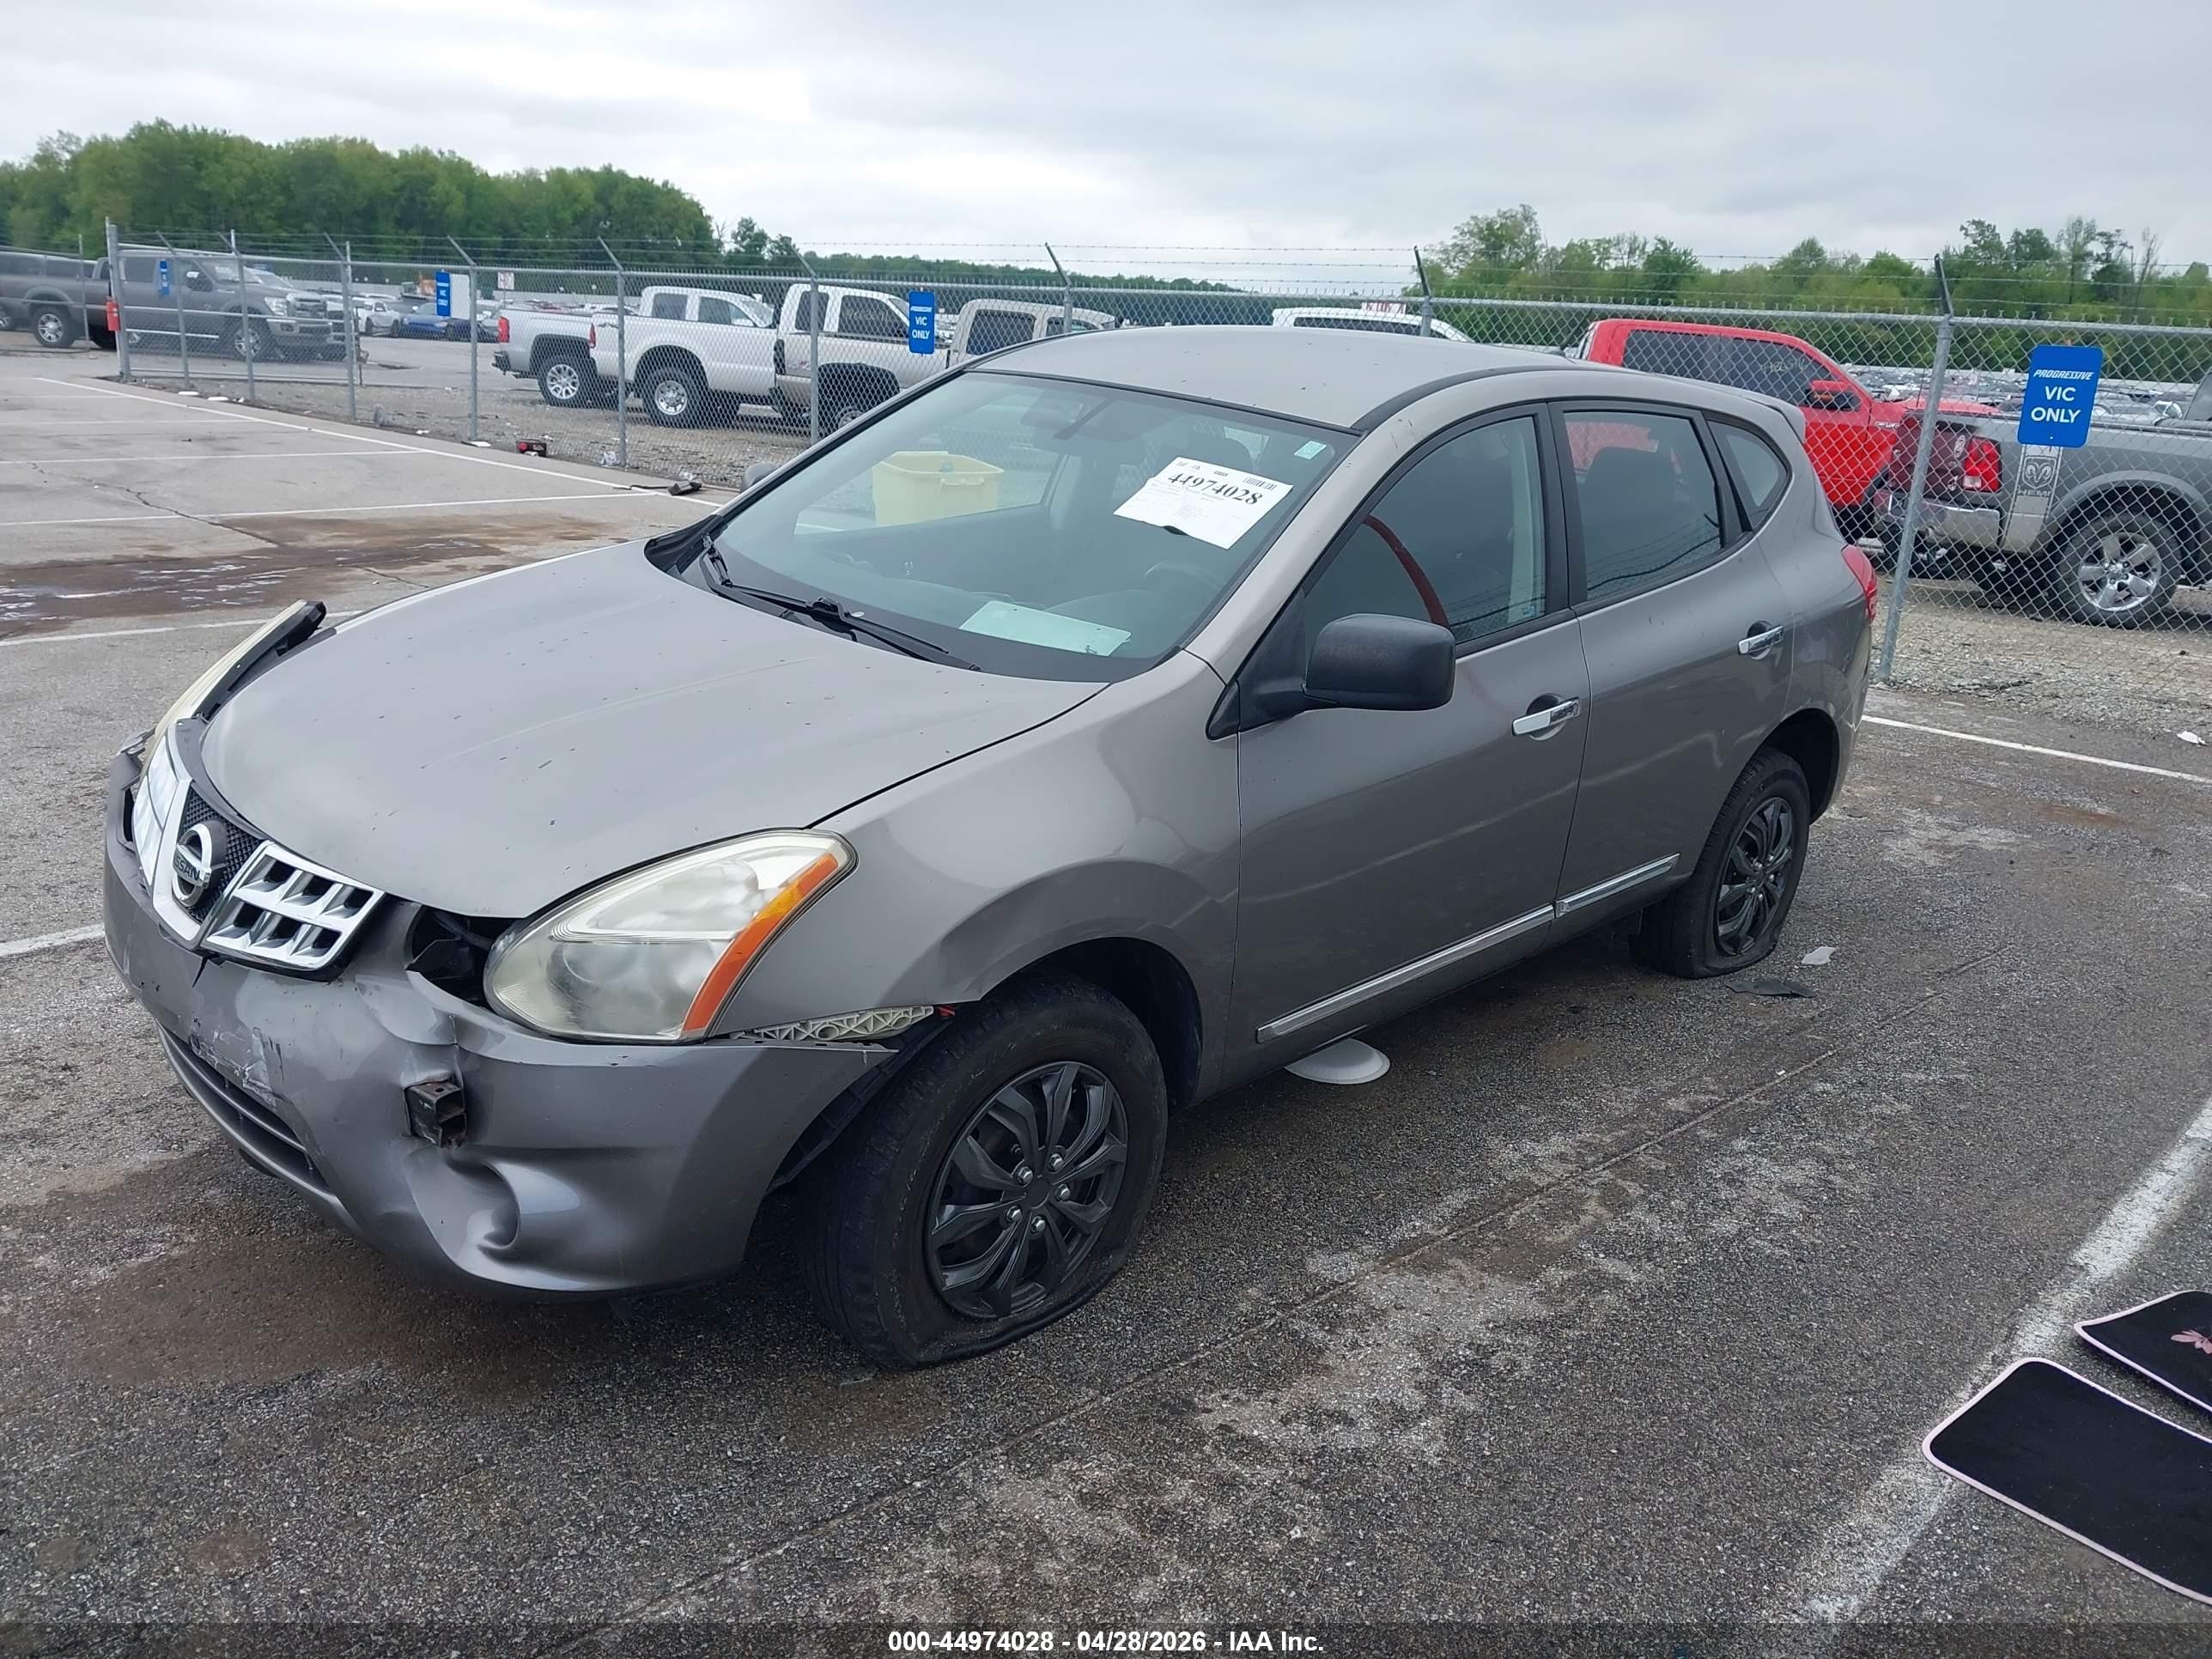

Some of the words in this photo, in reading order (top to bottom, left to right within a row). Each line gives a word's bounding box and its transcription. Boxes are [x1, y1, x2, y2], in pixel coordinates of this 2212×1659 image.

[915, 316, 927, 325] VIC
[911, 329, 931, 339] ONLY
[2033, 369, 2094, 380] PROGRESSIVE
[2045, 386, 2076, 402] VIC
[2031, 406, 2081, 423] ONLY
[1168, 472, 1263, 505] 44974028
